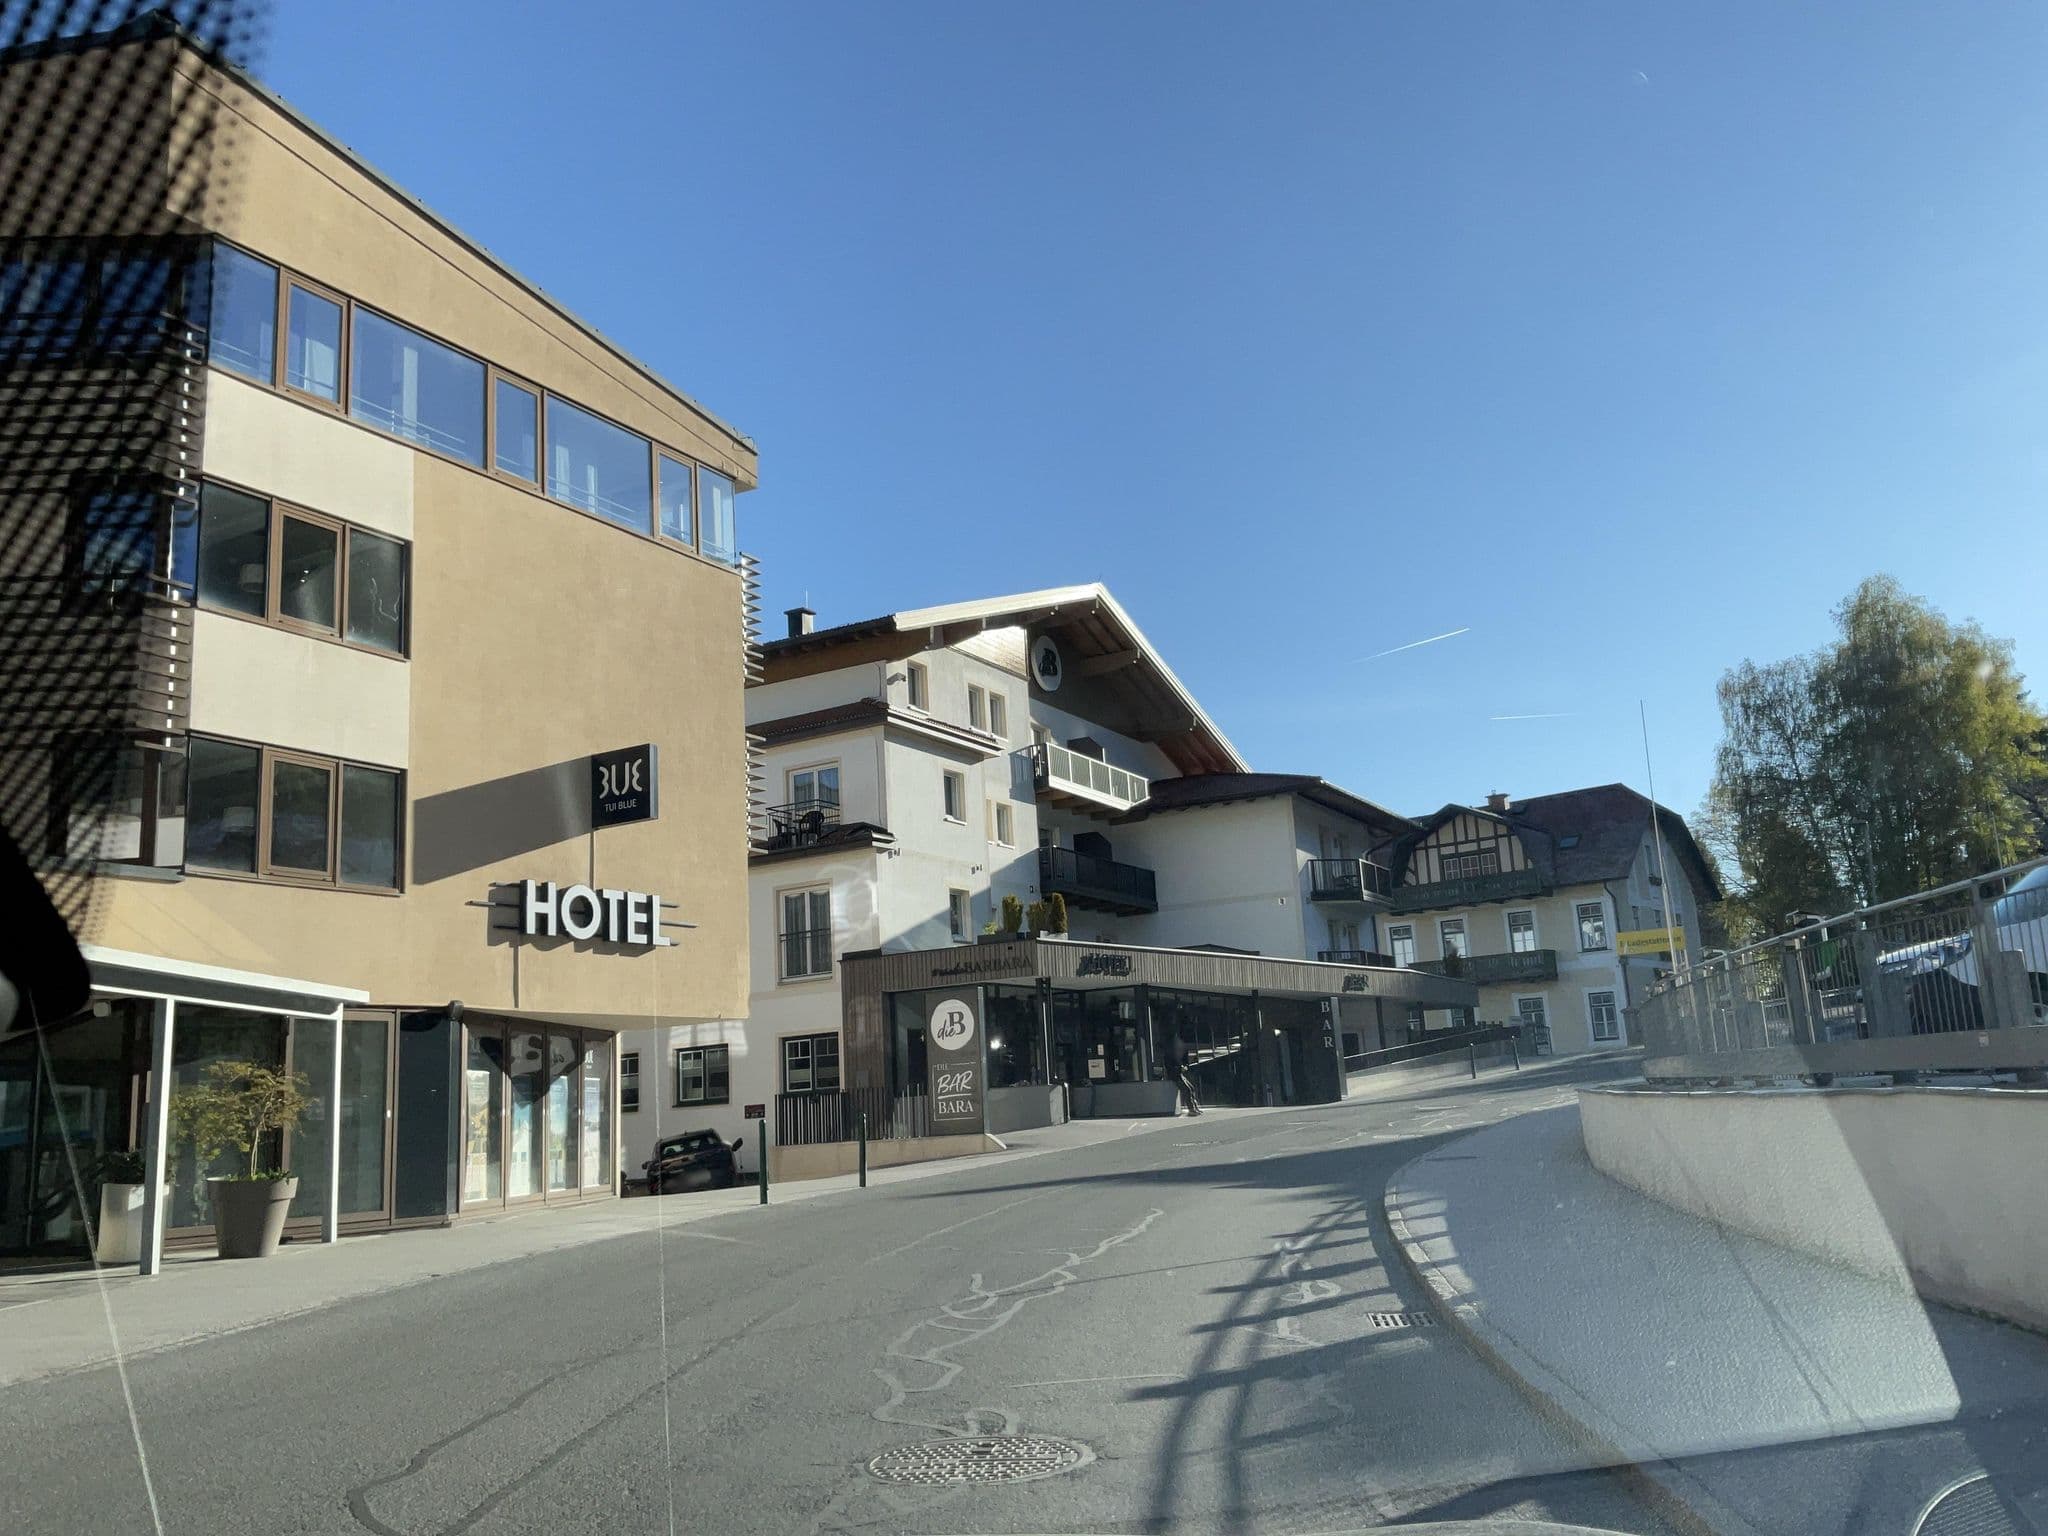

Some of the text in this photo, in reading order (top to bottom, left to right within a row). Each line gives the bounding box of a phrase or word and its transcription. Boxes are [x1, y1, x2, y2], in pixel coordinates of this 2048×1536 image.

[605, 799, 637, 812] TUI BLUE
[525, 879, 671, 946] HOTEL
[1320, 1001, 1335, 1048] BAR
[937, 1070, 973, 1094] BAR
[938, 1100, 974, 1114] BARA
